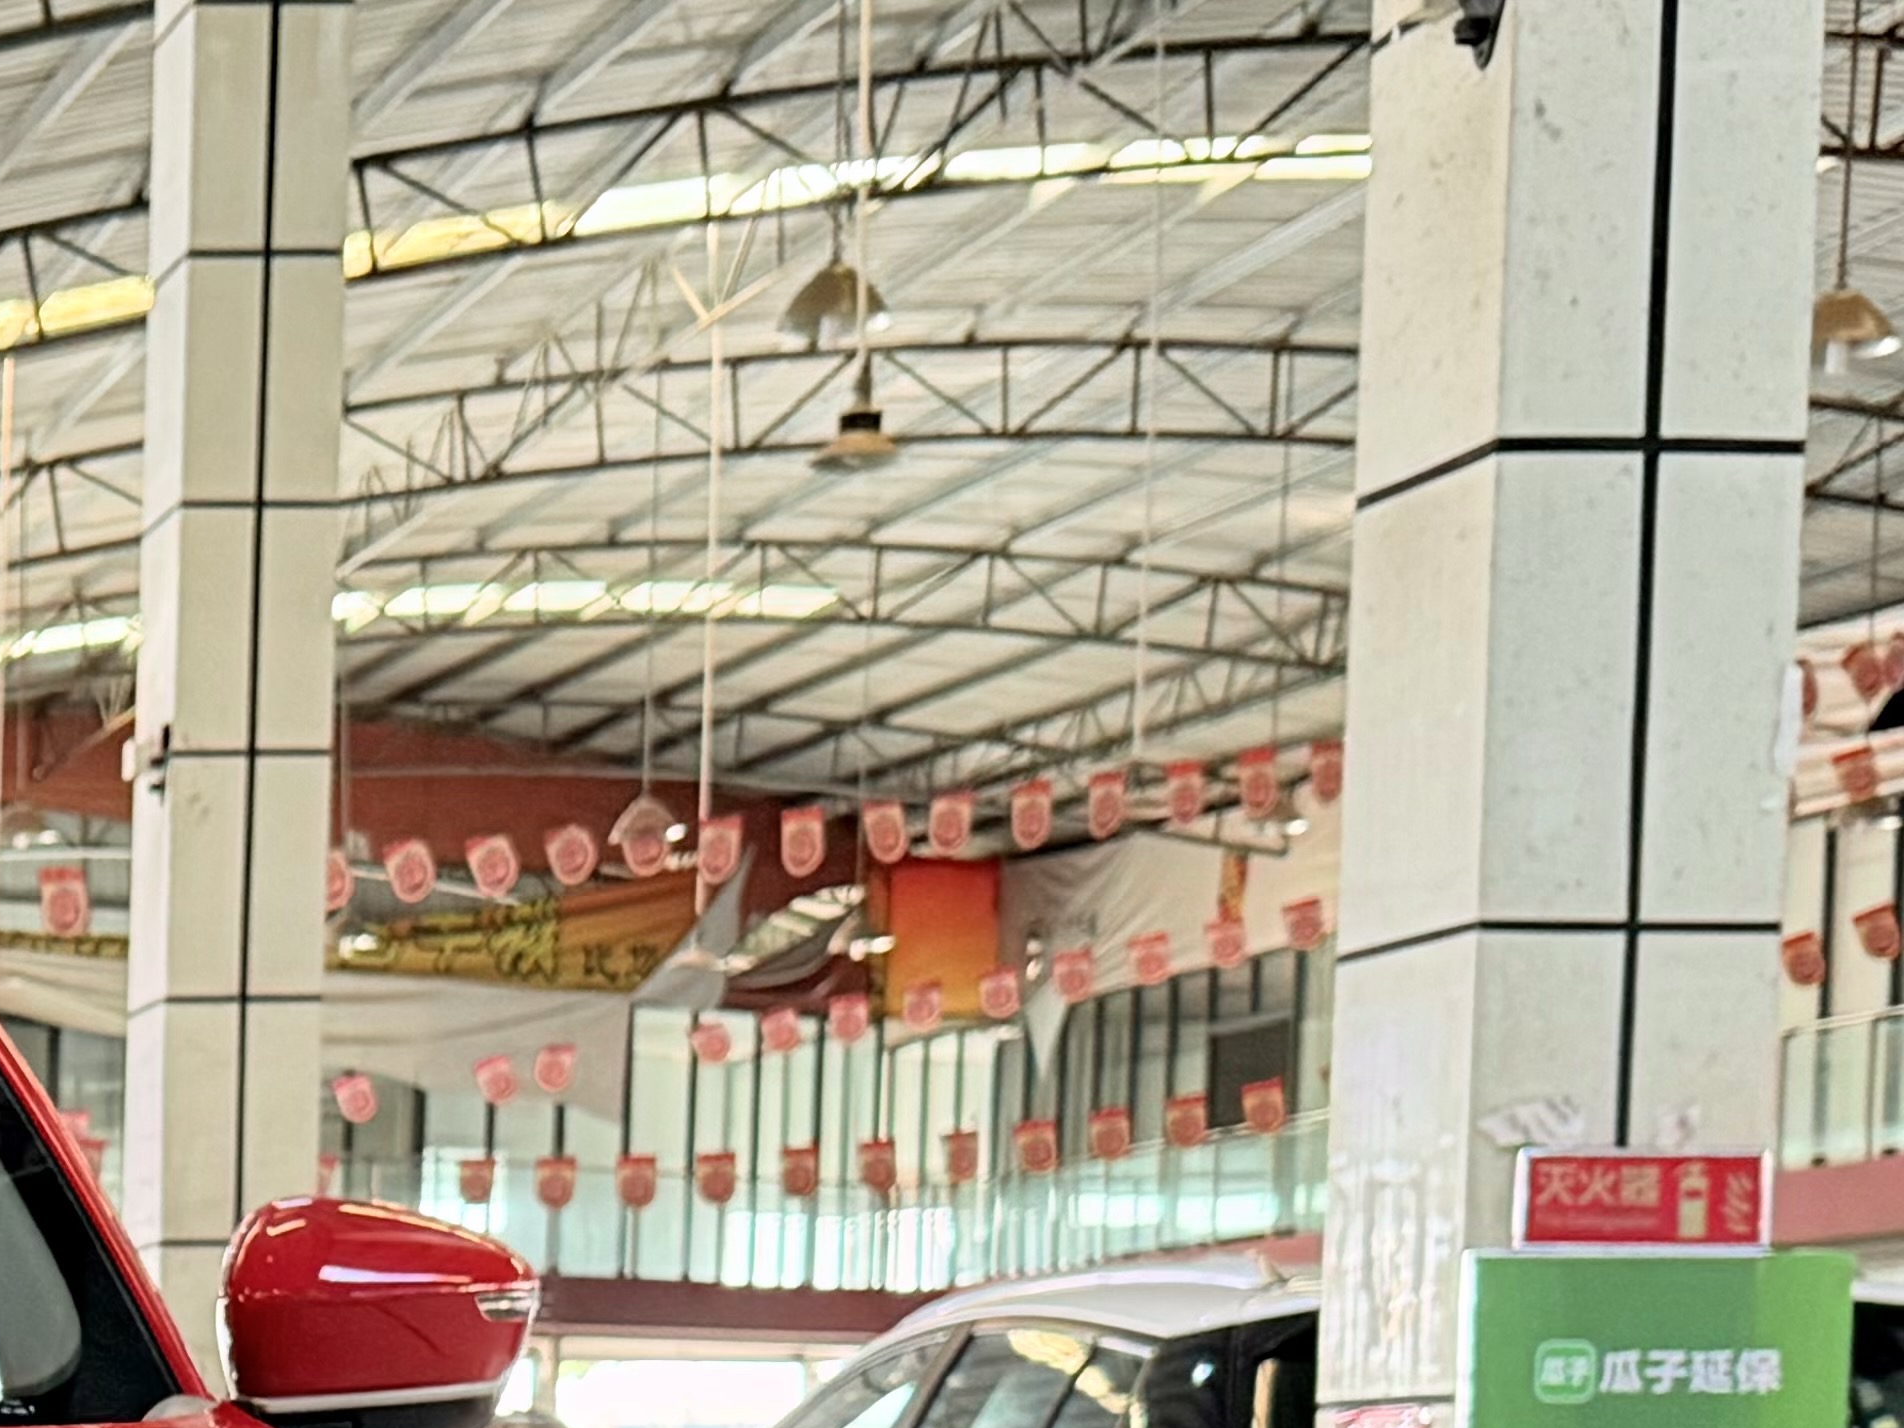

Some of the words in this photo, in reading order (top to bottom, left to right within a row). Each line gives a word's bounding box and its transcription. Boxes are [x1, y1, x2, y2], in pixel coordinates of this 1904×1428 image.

[1535, 1163, 1662, 1208] 灭火器
[1599, 1347, 1783, 1395] 瓜子延保
